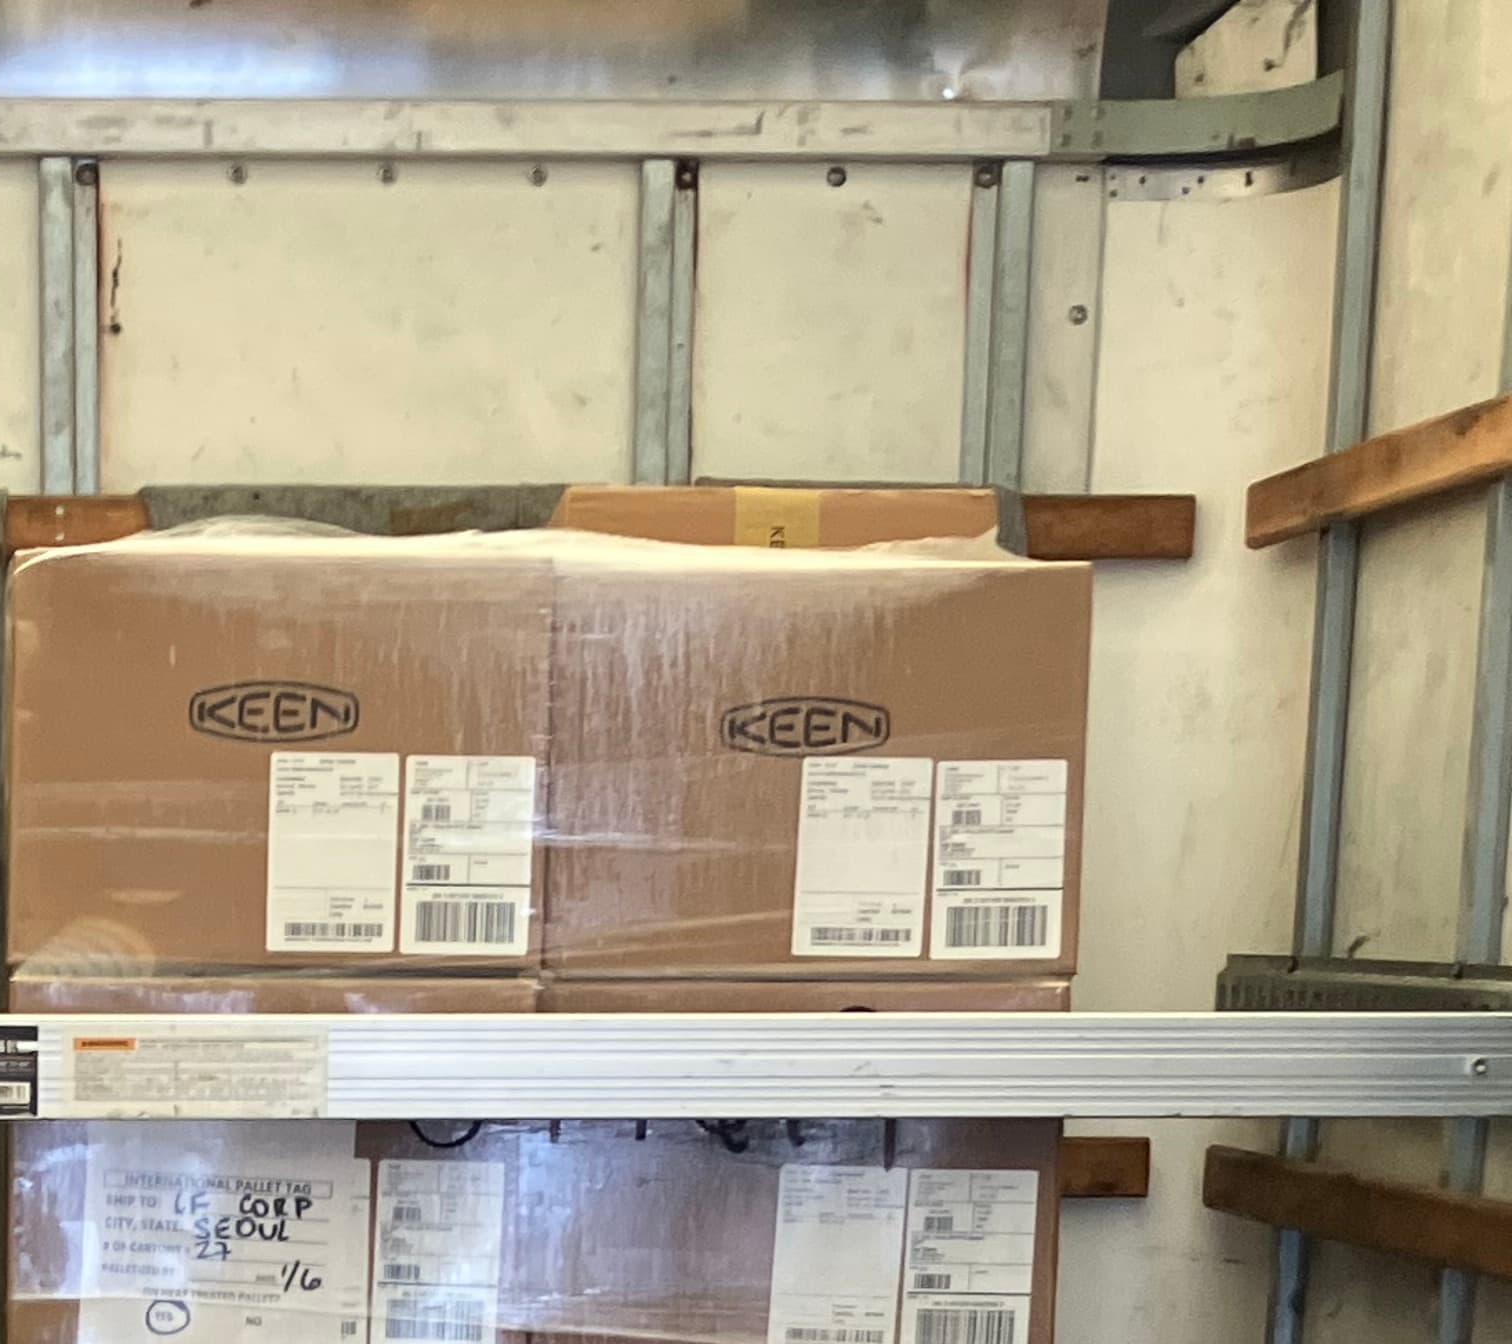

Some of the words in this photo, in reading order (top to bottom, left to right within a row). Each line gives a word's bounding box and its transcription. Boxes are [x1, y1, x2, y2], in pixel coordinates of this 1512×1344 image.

[197, 691, 351, 734] KEEN
[728, 707, 884, 748] KEEN
[235, 1180, 281, 1194] PALLET
[285, 1182, 312, 1195] TAG
[238, 1193, 314, 1220] CORP
[193, 1216, 290, 1242] SEOUL
[193, 1240, 232, 1262] 27
[281, 1259, 323, 1293] 1/6
[245, 1316, 263, 1327] NO
